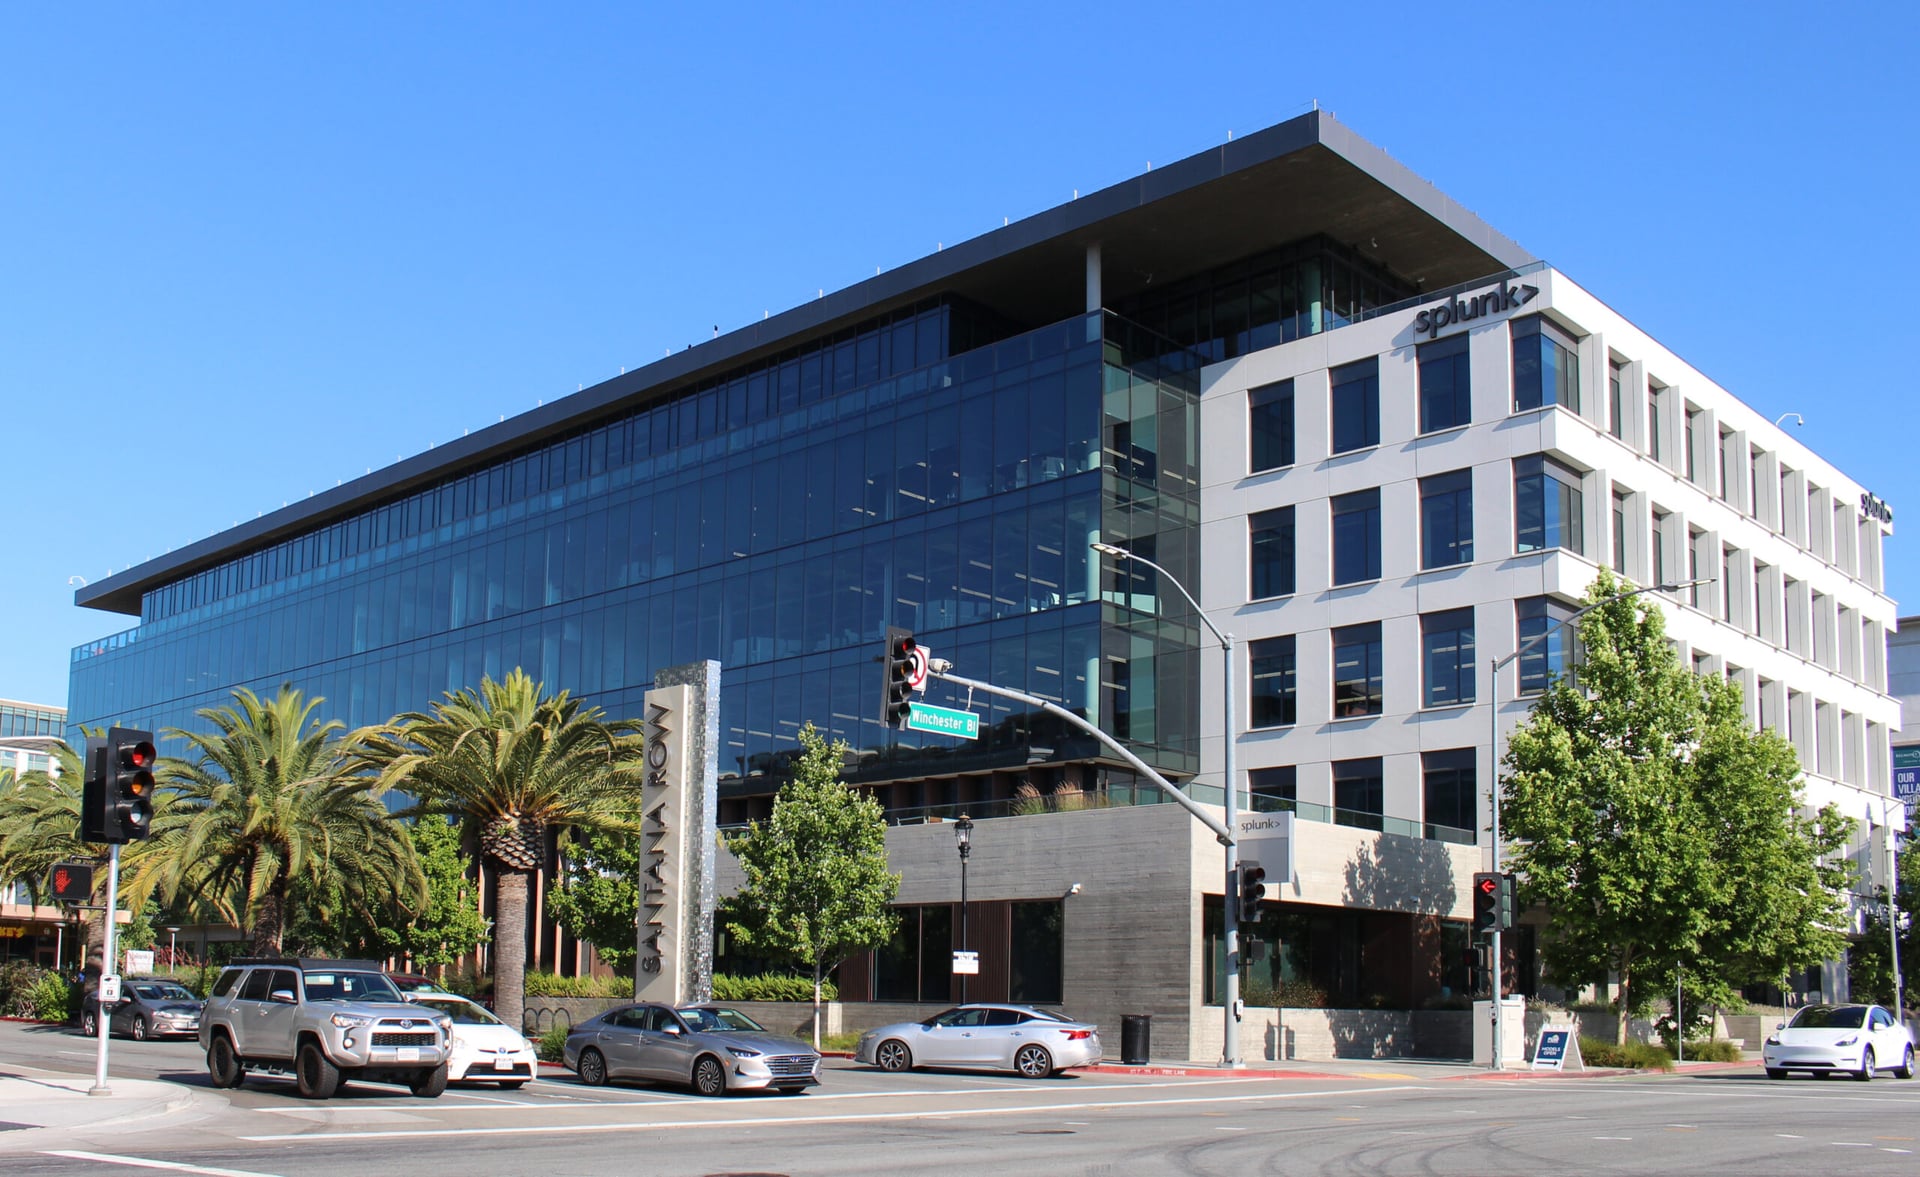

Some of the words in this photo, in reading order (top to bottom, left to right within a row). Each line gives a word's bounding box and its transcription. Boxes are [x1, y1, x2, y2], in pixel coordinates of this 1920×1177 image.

[648, 703, 672, 787] ROW
[912, 710, 963, 730] Winchester
[1897, 772, 1915, 784] OUR
[642, 801, 667, 975] SANTANA
